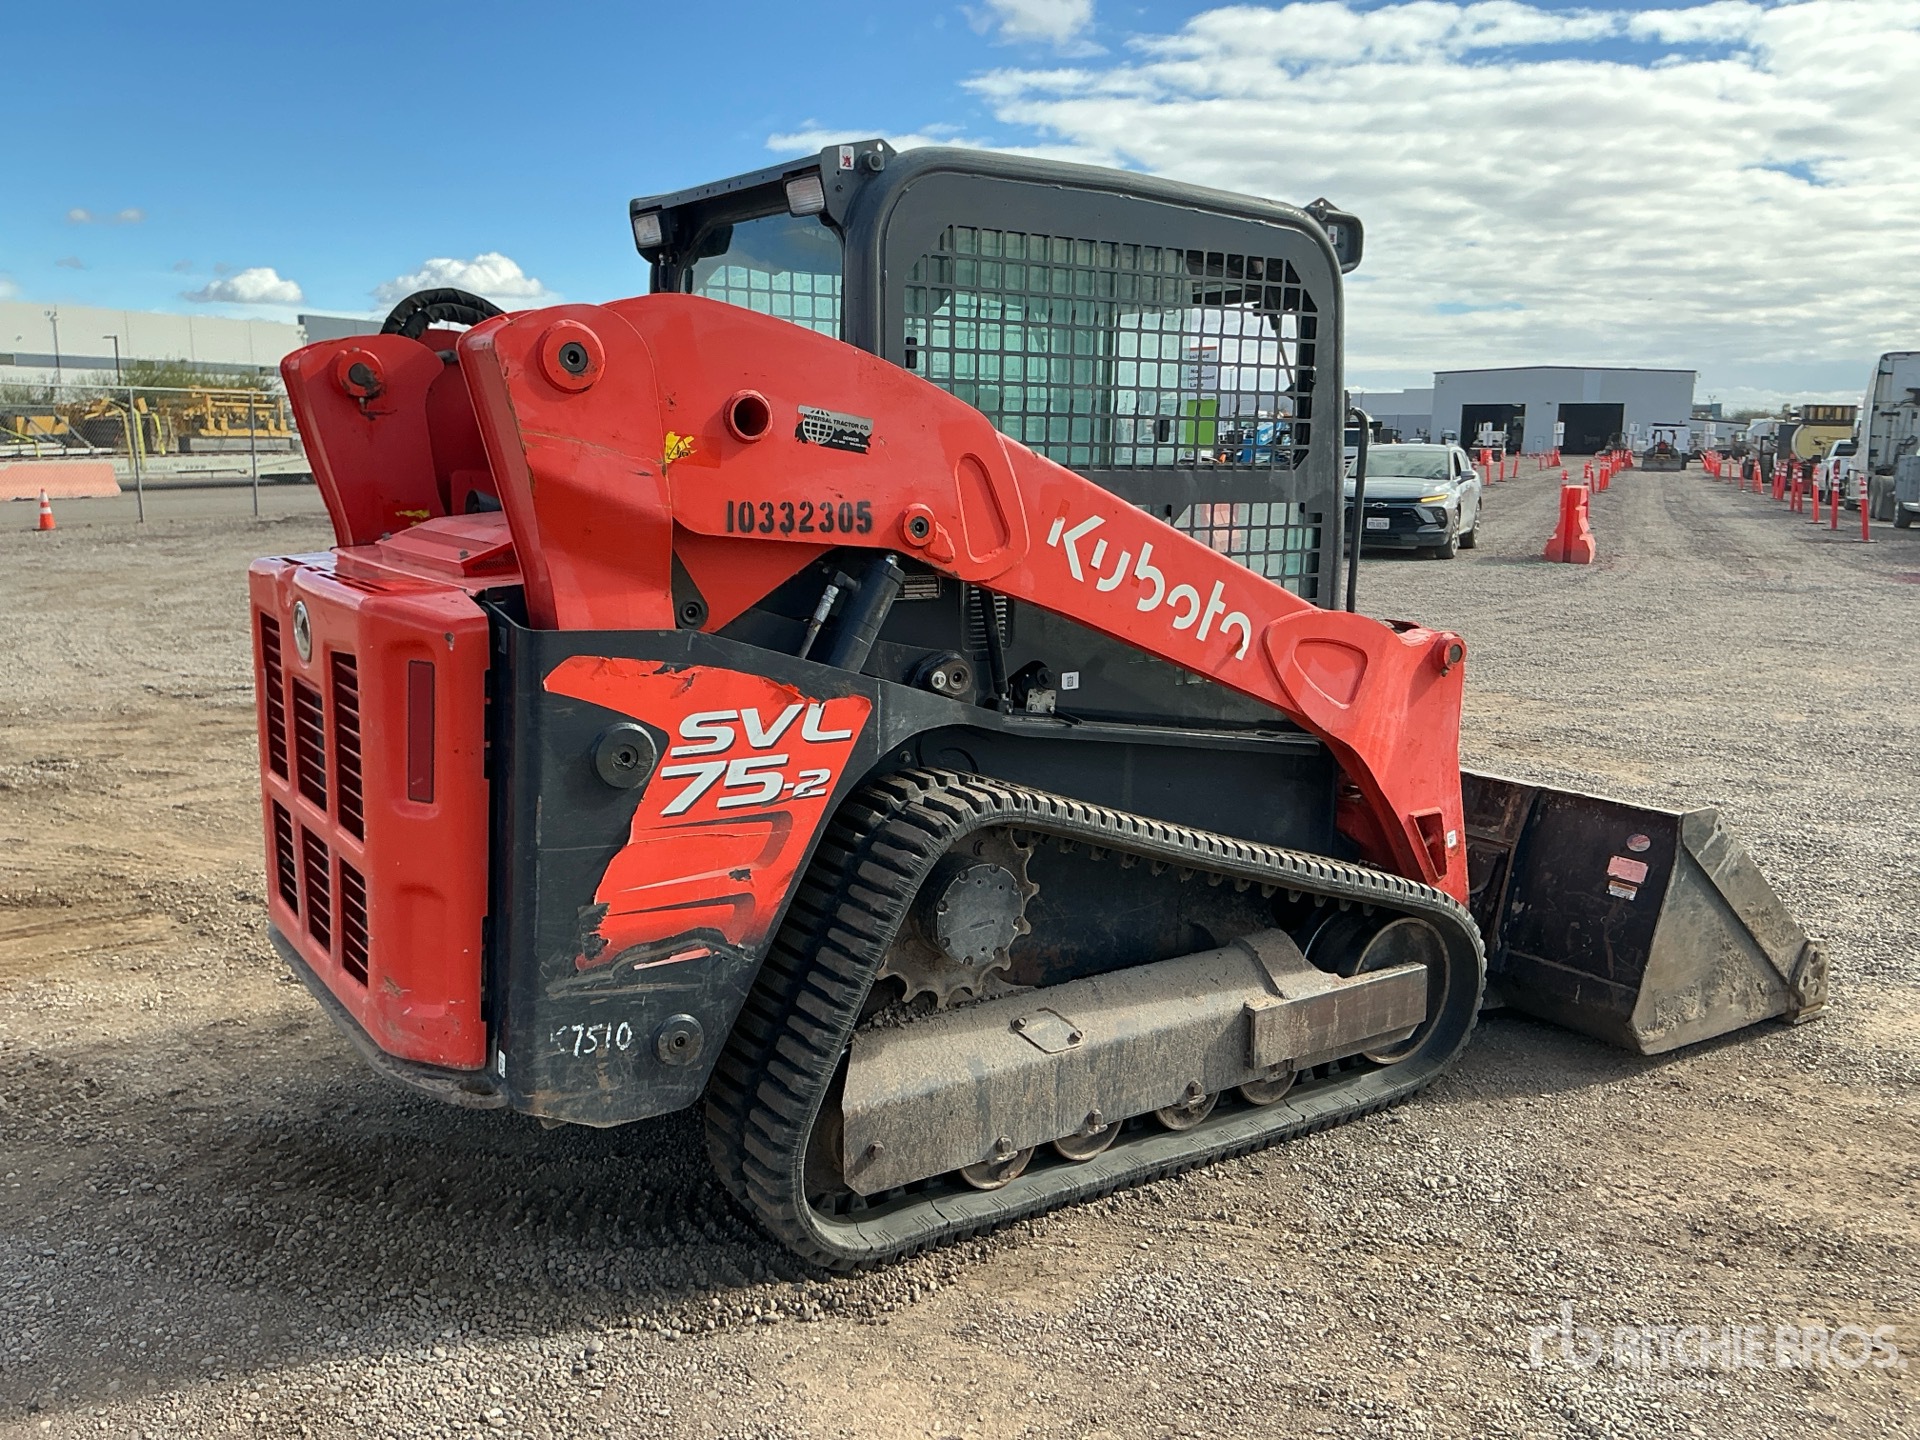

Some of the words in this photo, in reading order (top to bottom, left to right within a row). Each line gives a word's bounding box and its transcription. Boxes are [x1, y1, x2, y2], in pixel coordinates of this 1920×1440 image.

[833, 419, 859, 429] TRACTOR
[726, 500, 873, 534] 10332305
[1047, 515, 1252, 661] Kubota
[669, 702, 852, 758] SVL
[659, 753, 831, 818] 75-2
